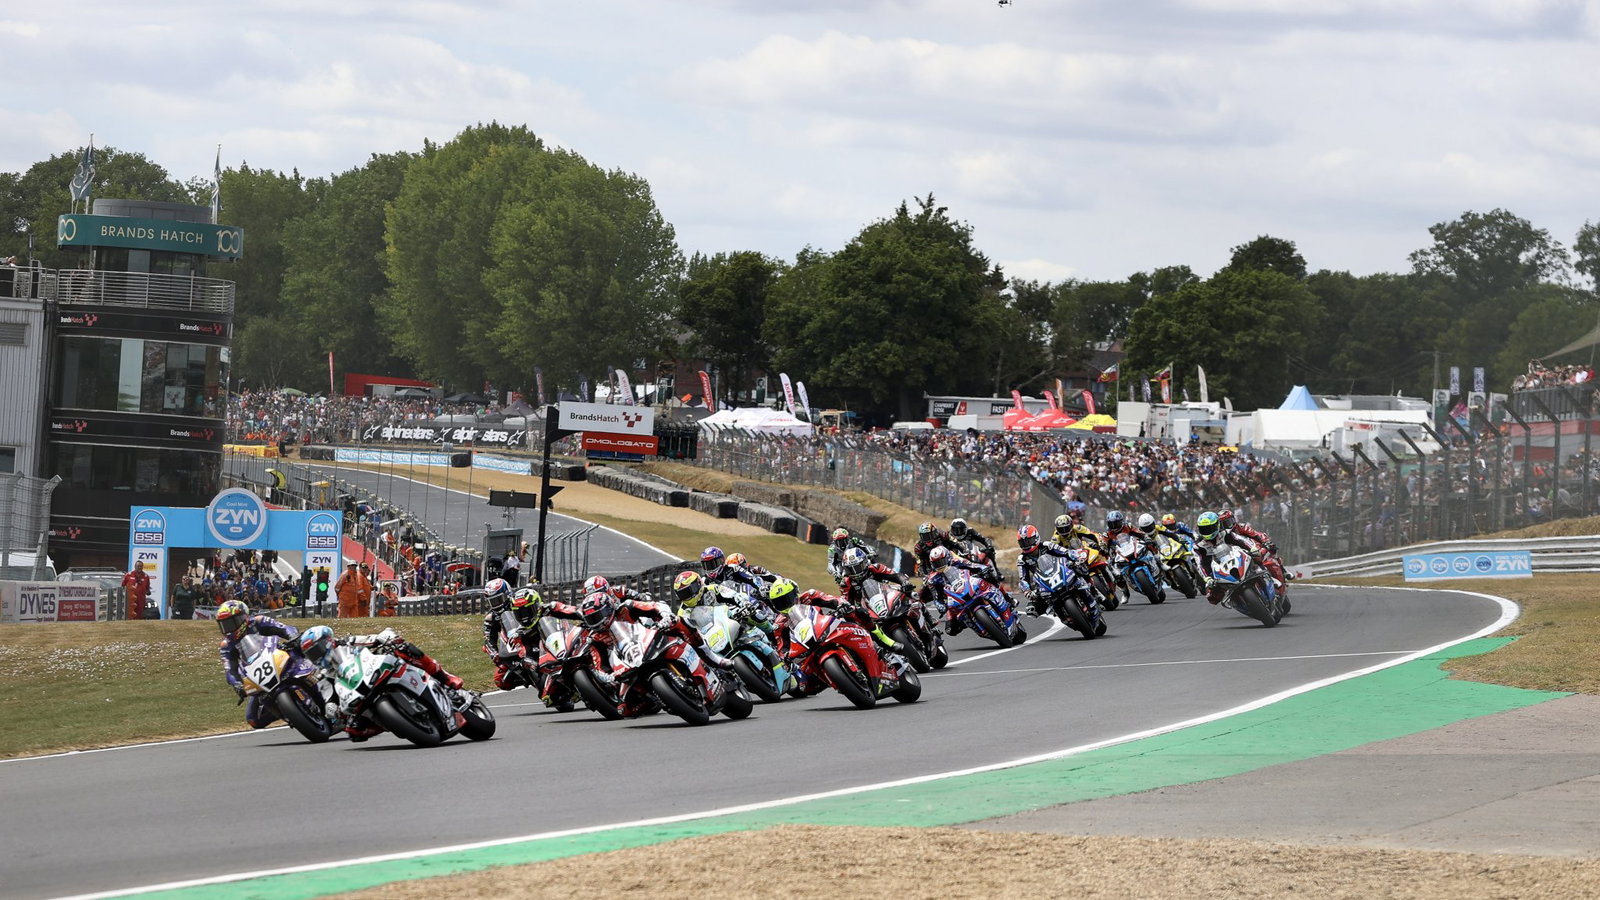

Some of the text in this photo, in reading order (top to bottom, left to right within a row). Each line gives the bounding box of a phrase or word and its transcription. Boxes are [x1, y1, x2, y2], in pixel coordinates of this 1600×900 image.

[101, 225, 203, 244] BRANDS HATCH
[216, 229, 240, 254] 100
[569, 412, 619, 423] BrandsHatch
[381, 424, 435, 441] alpinestars
[452, 426, 508, 443] alpistars
[586, 438, 654, 448] OMOLOGATO
[215, 508, 258, 525] ZYN
[137, 519, 161, 529] ZYN
[311, 523, 335, 532] ZYN
[135, 532, 163, 541] BSB
[309, 537, 336, 546] BSB
[138, 552, 158, 560] ZYN
[312, 556, 332, 564] ZYN
[1496, 559, 1529, 571] ZYN
[20, 593, 56, 614] DYNES
[254, 661, 274, 684] 28
